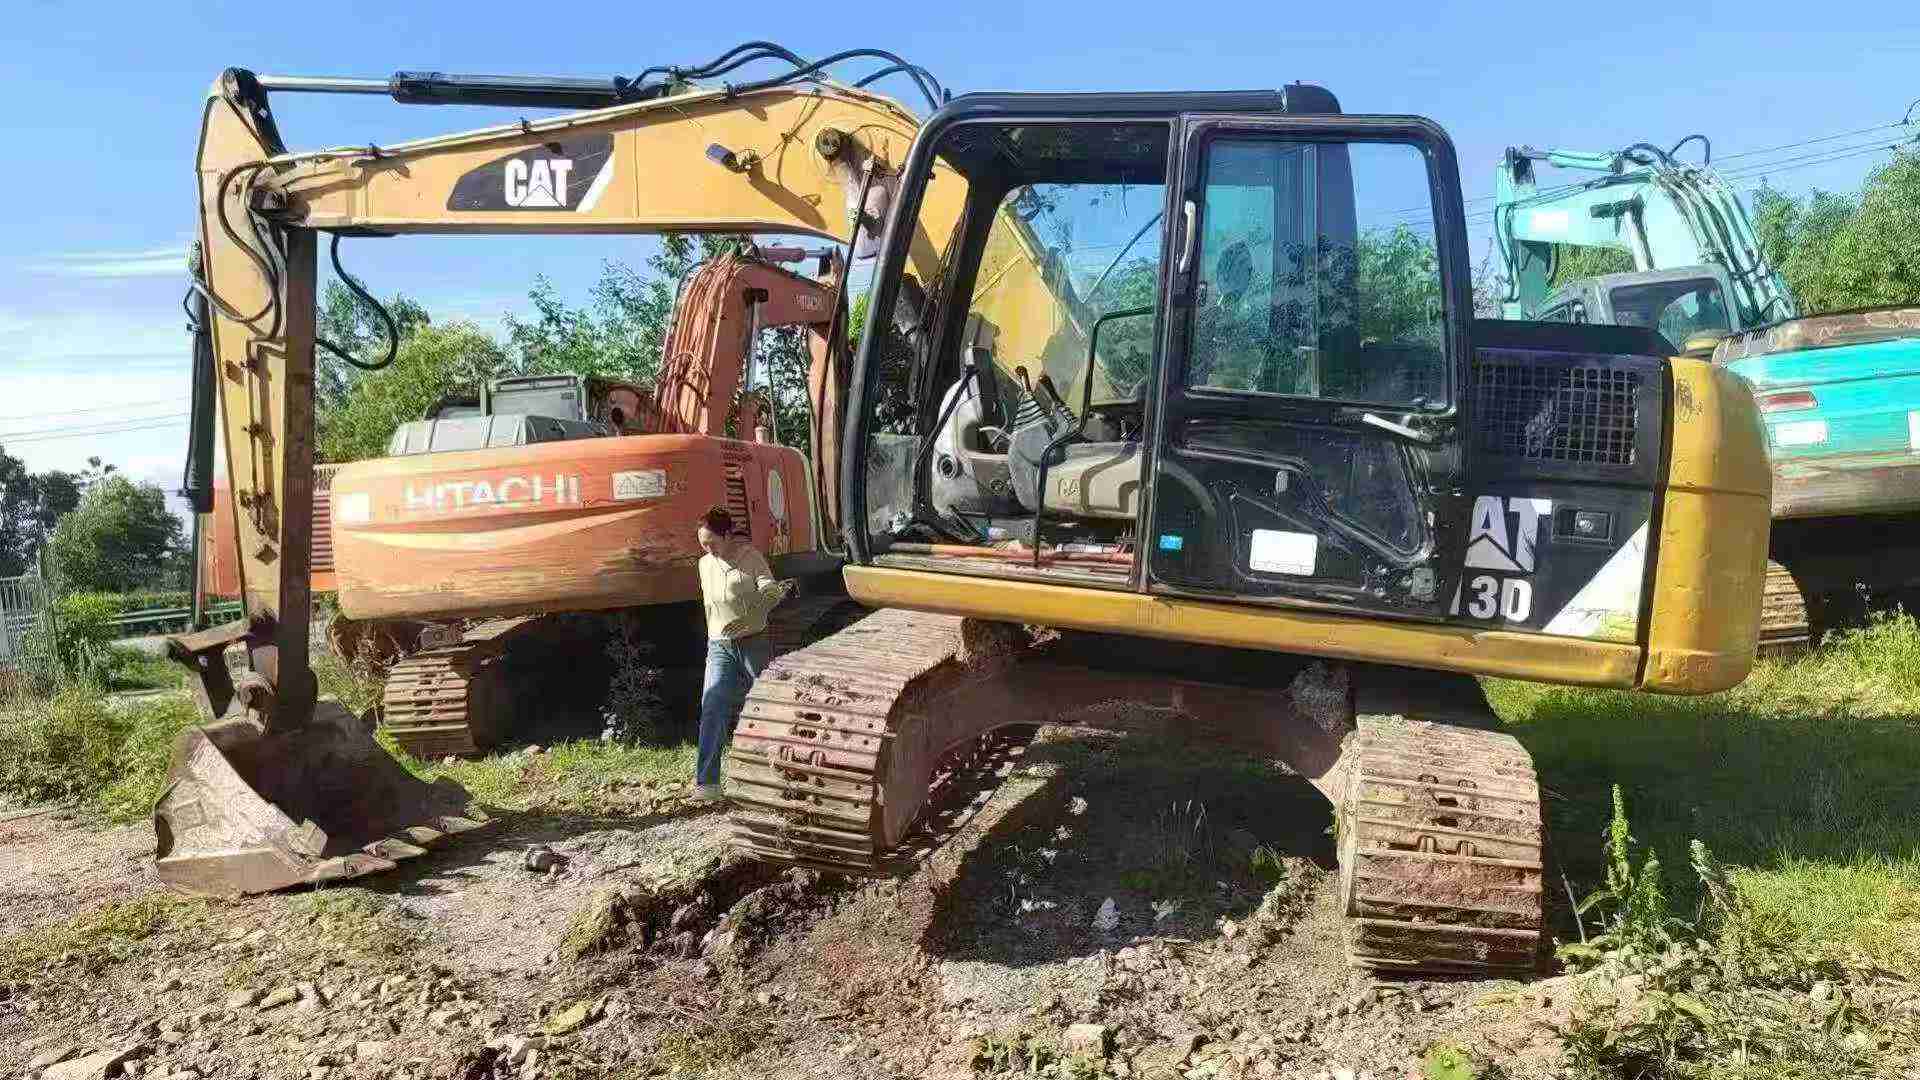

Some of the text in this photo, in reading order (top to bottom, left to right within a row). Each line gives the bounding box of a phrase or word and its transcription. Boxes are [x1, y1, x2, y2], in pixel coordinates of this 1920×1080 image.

[504, 158, 573, 207] CAT
[403, 472, 581, 511] HITACHI
[1464, 495, 1553, 573] AT
